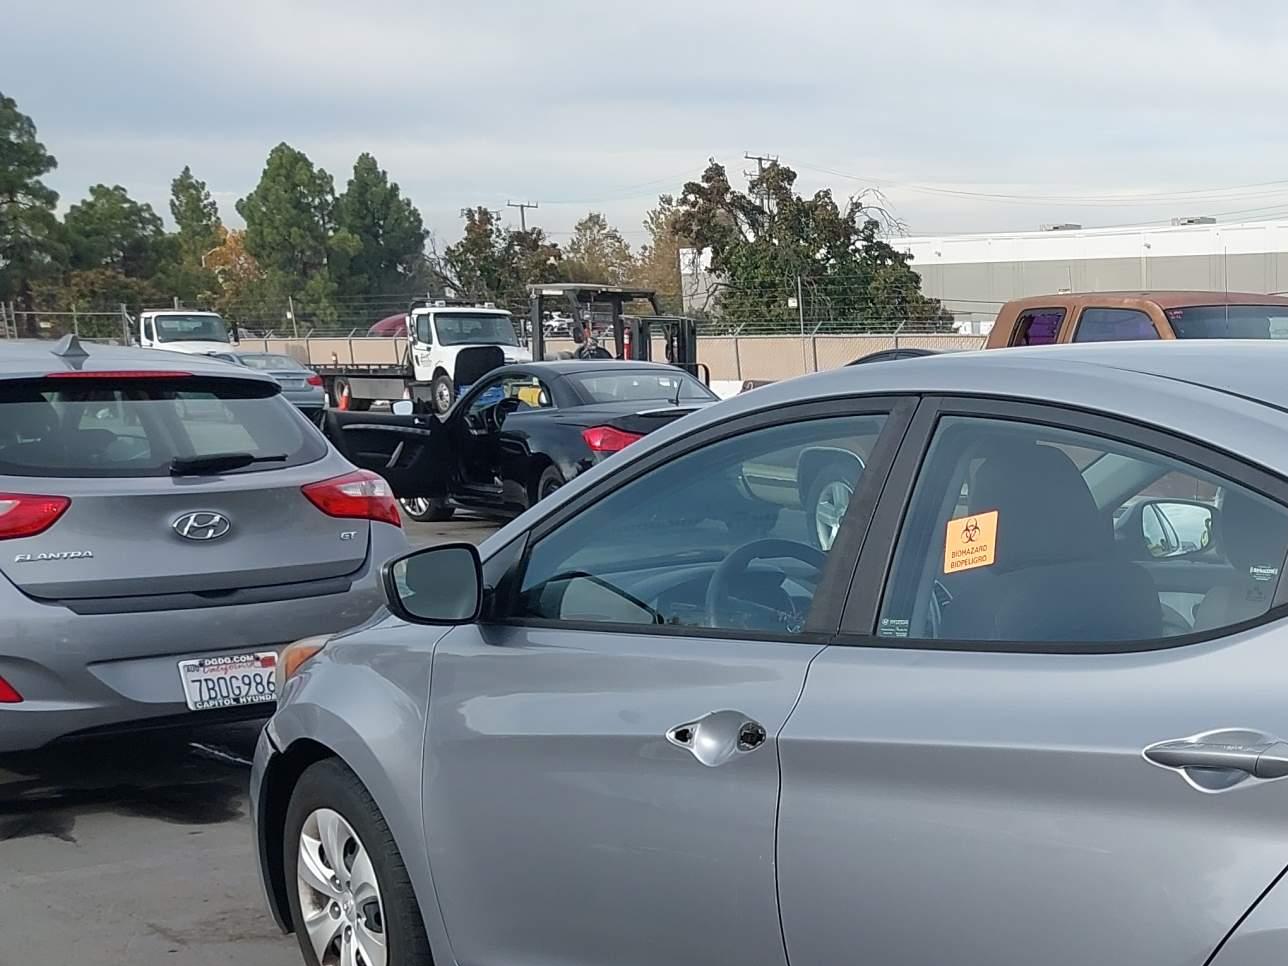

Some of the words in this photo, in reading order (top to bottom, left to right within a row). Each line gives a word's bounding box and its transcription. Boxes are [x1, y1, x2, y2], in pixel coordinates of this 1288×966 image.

[340, 531, 358, 541] GT
[14, 550, 94, 562] ELANTRA
[951, 544, 988, 559] BIOHAZARD
[950, 555, 988, 569] BIOPELIGRO
[196, 697, 238, 709] CAPITOL
[239, 693, 277, 705] HYUNDA
